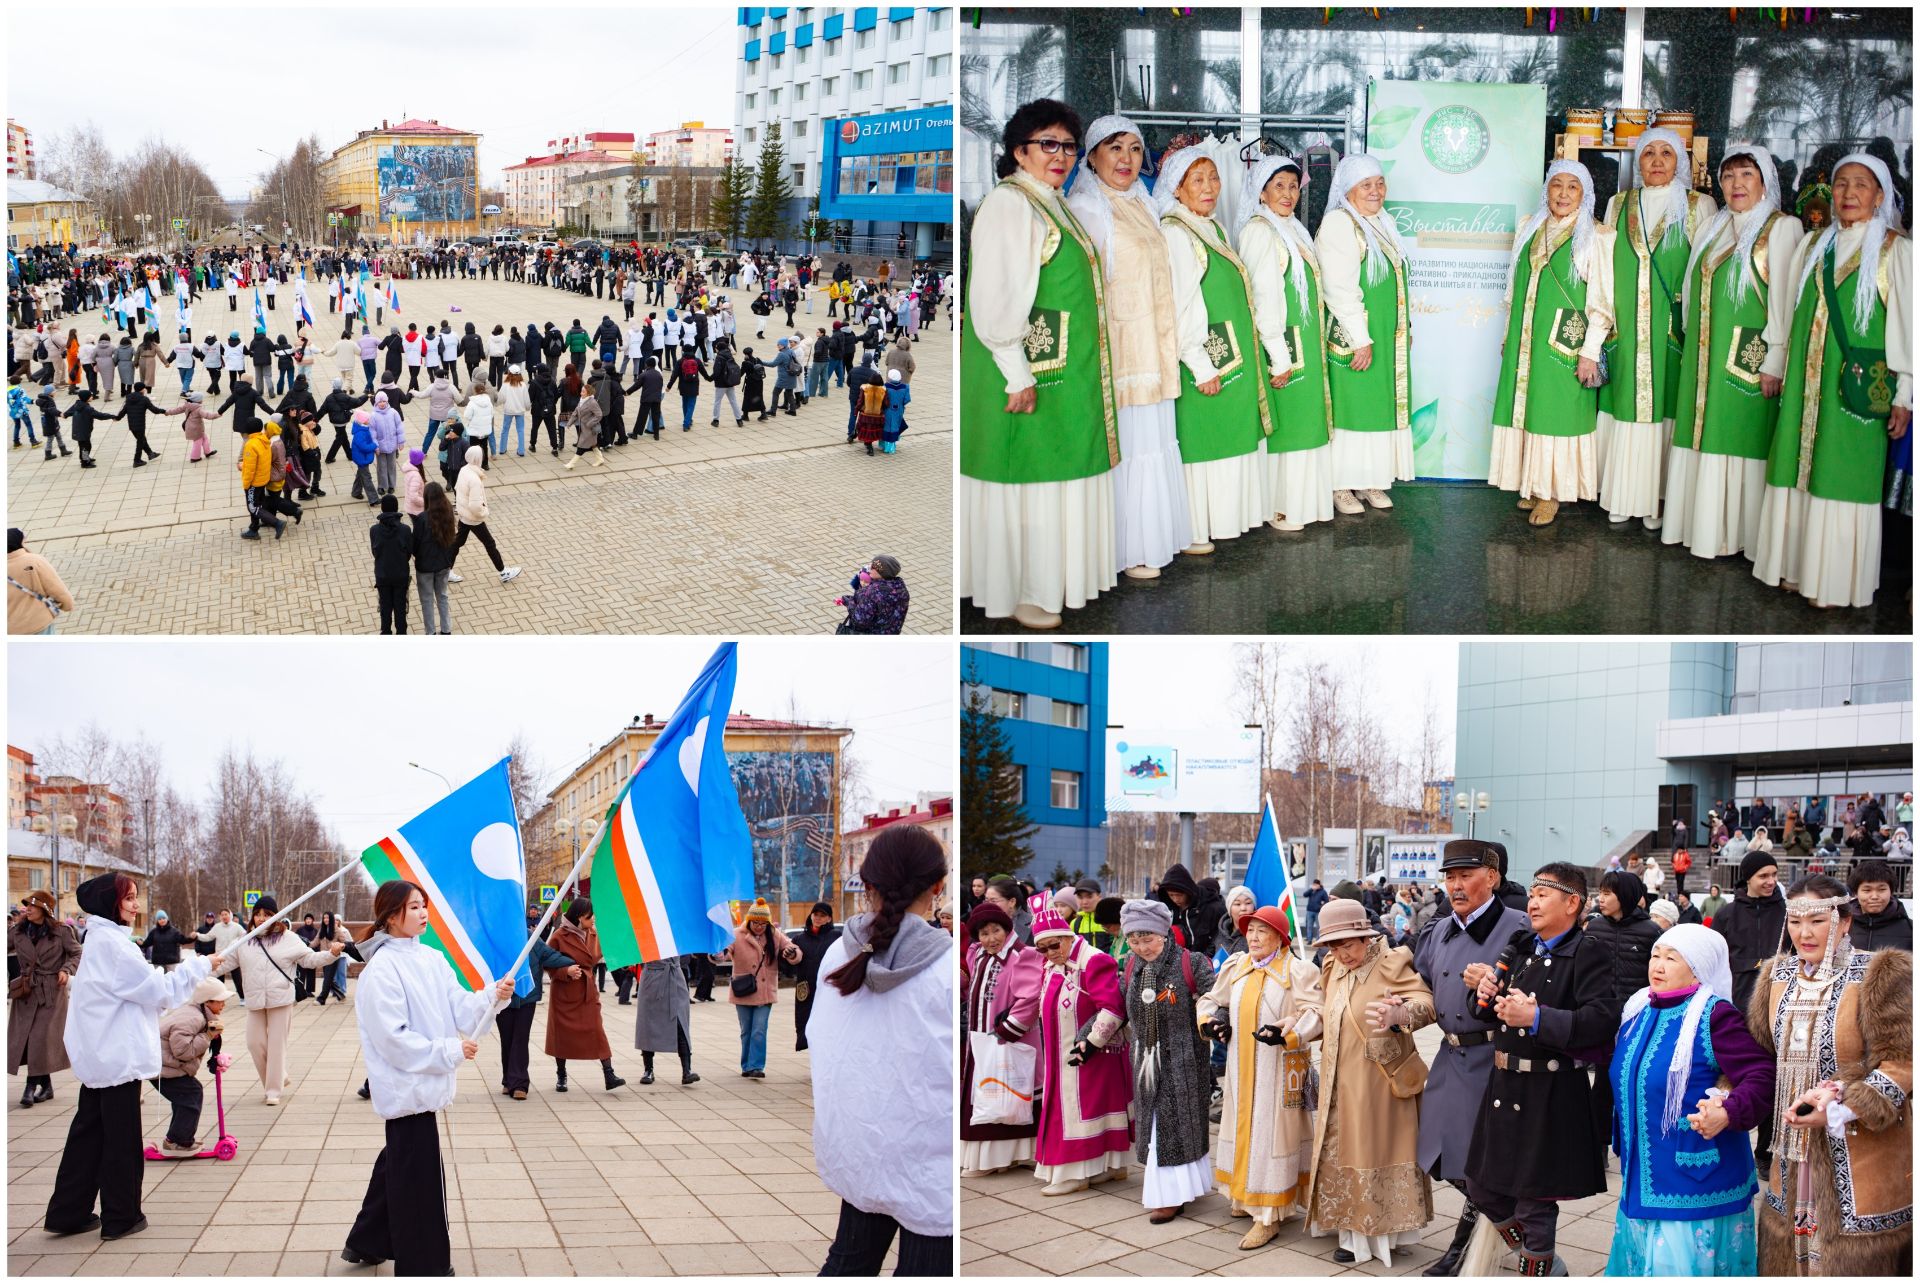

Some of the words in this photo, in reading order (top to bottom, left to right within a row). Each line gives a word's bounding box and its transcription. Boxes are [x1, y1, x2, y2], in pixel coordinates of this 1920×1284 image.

[1387, 205, 1507, 234] Выставка
[1418, 260, 1457, 269] РАЗВИТИЮ
[1453, 272, 1506, 280] ПРИКЛАДНОГО
[1440, 281, 1466, 289] ШИТЬЯ
